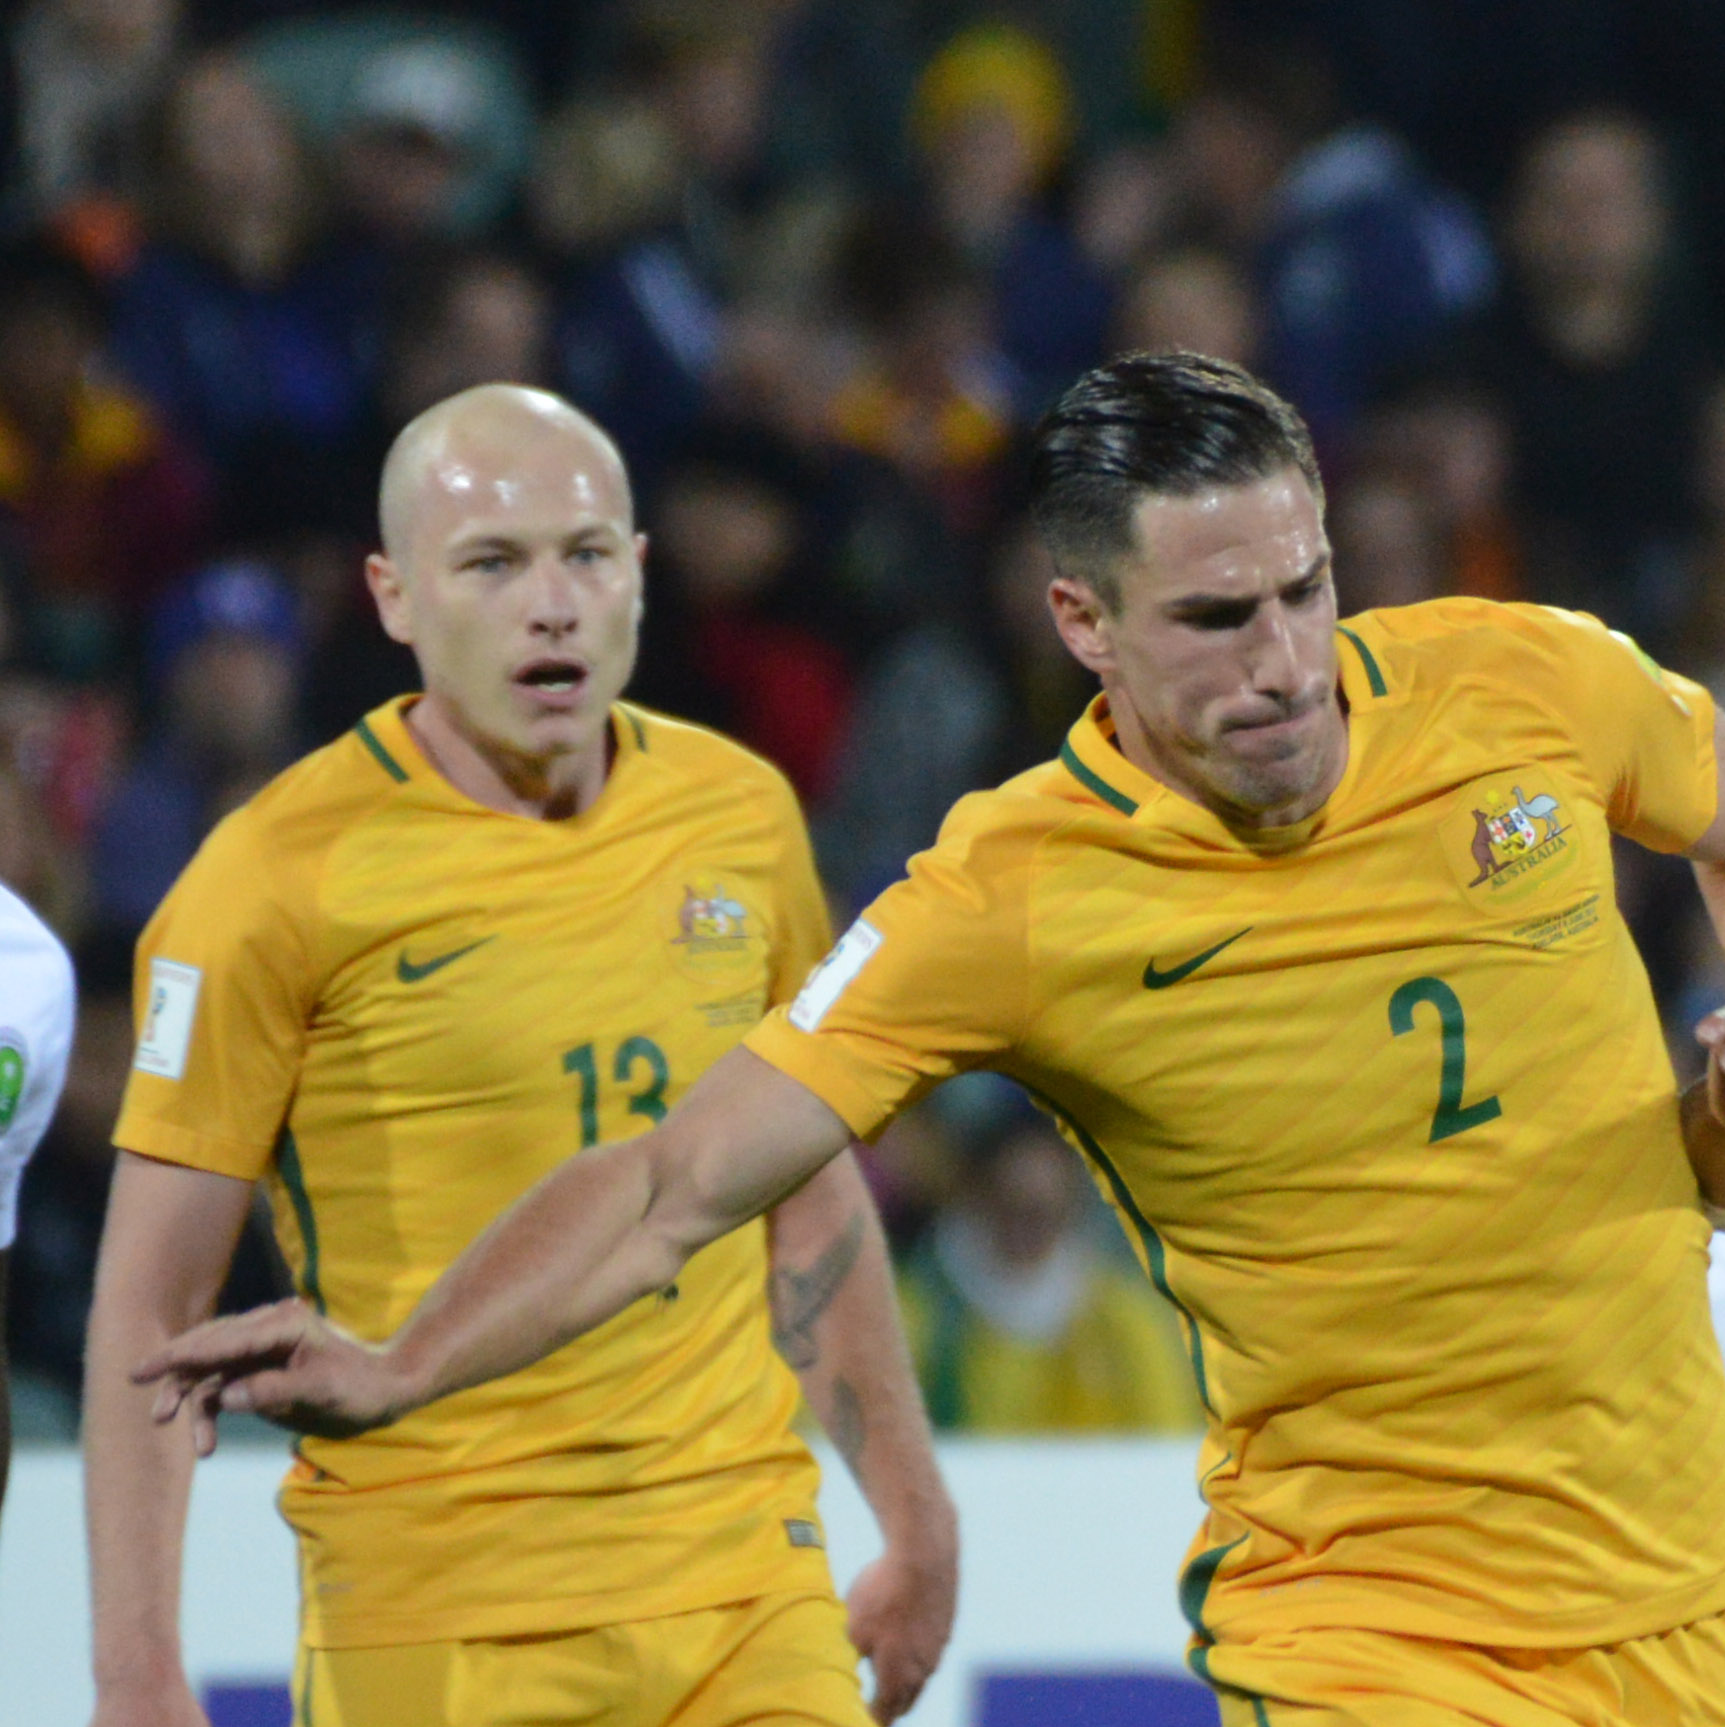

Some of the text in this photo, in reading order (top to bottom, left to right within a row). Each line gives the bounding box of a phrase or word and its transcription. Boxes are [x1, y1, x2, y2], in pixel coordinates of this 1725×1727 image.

[1491, 835, 1568, 890] AUSTRALIA
[563, 1036, 669, 1147] 13
[1387, 975, 1502, 1143] 2
